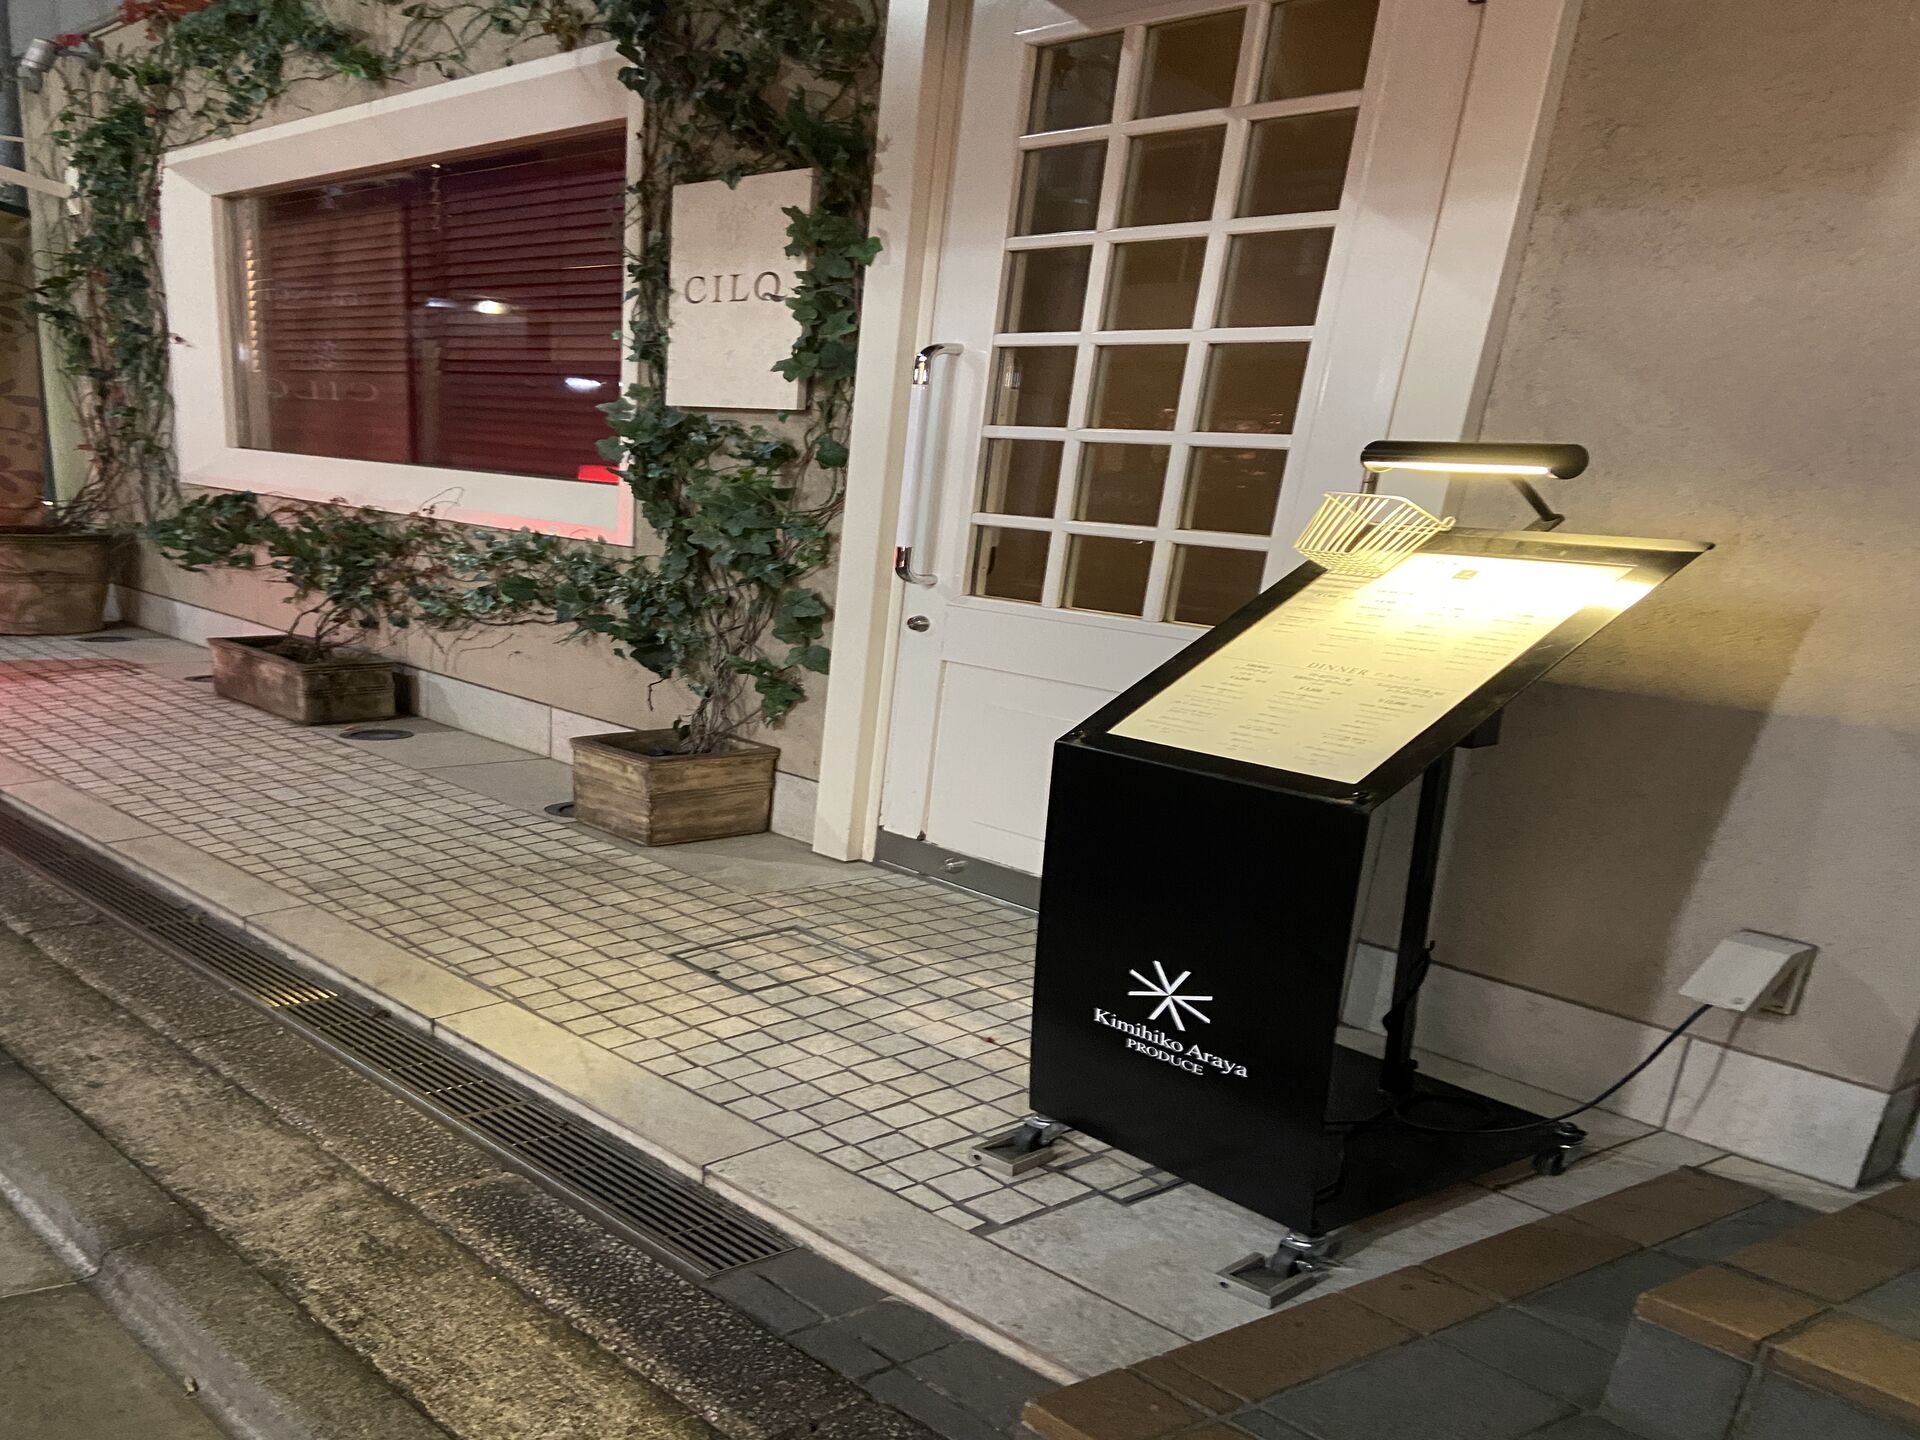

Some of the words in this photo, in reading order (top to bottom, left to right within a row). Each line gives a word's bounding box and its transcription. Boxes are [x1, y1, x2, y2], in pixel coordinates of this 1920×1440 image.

[684, 270, 788, 305] CILQ
[1306, 661, 1370, 676] DINNER
[1093, 1007, 1184, 1053] Kimihiko
[1185, 1044, 1249, 1078] Araya
[1125, 1037, 1204, 1076] PRODUCE
